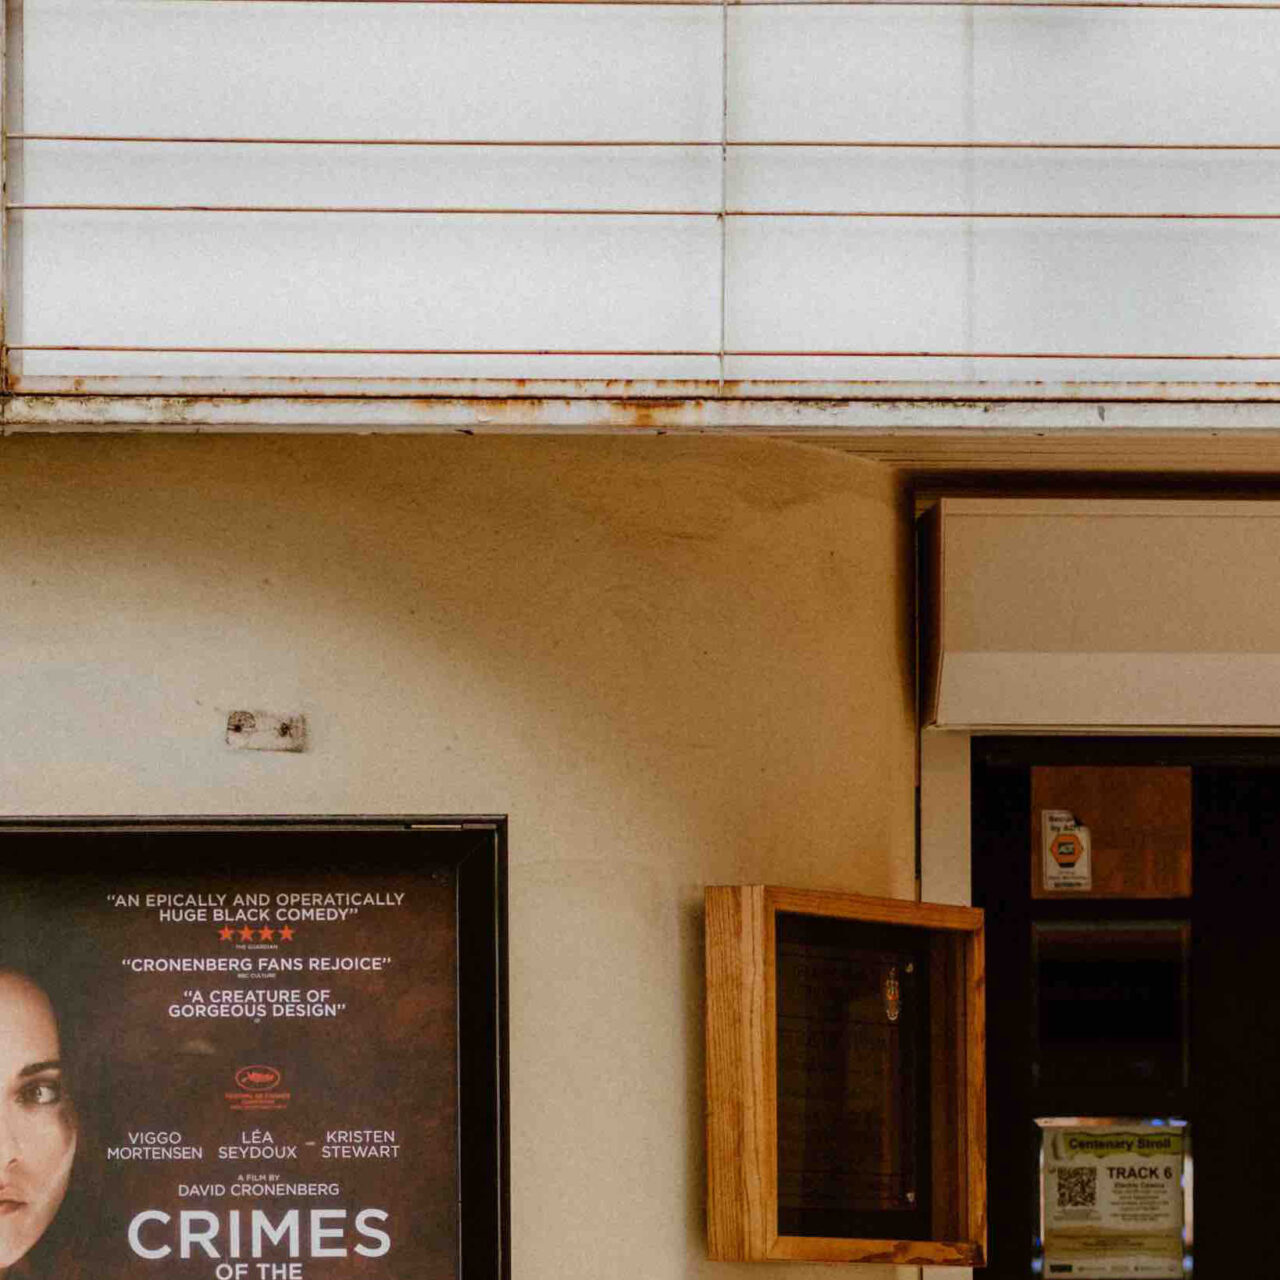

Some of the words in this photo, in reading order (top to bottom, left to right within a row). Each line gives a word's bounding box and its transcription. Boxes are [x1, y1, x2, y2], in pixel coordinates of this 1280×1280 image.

[107, 894, 140, 907] “AN
[145, 893, 226, 907] EPICALLY
[233, 893, 270, 907] AND
[276, 893, 405, 906] OPERATICALLY
[159, 909, 207, 922] HUGE
[213, 909, 270, 922] BLACK
[276, 908, 359, 921] COMEDY”
[122, 958, 252, 972] “CRONENBERG
[258, 958, 303, 971] FANS
[309, 957, 392, 971] REJOICE”
[183, 990, 203, 1004] “A
[210, 990, 301, 1003] CREATURE
[307, 990, 330, 1003] OF
[169, 1005, 267, 1018] GORGEOUS
[272, 1004, 347, 1018] DESIGN”
[128, 1132, 182, 1144] VIGGO
[242, 1129, 273, 1144] LÉA
[327, 1130, 395, 1143] KRISTEN
[1069, 1138, 1134, 1151] Centenary
[1138, 1137, 1171, 1148] Stroll
[107, 1147, 203, 1160] MORTENSEN
[218, 1146, 298, 1159] SEYDOUX
[321, 1145, 400, 1158] STEWART
[1106, 1167, 1160, 1180] TRACK
[1164, 1167, 1172, 1180] 6
[178, 1184, 226, 1197] DAVID
[231, 1183, 339, 1197] CRONENBERG
[127, 1208, 391, 1260] CRIMES
[215, 1263, 249, 1280] OF
[256, 1263, 303, 1280] THE
